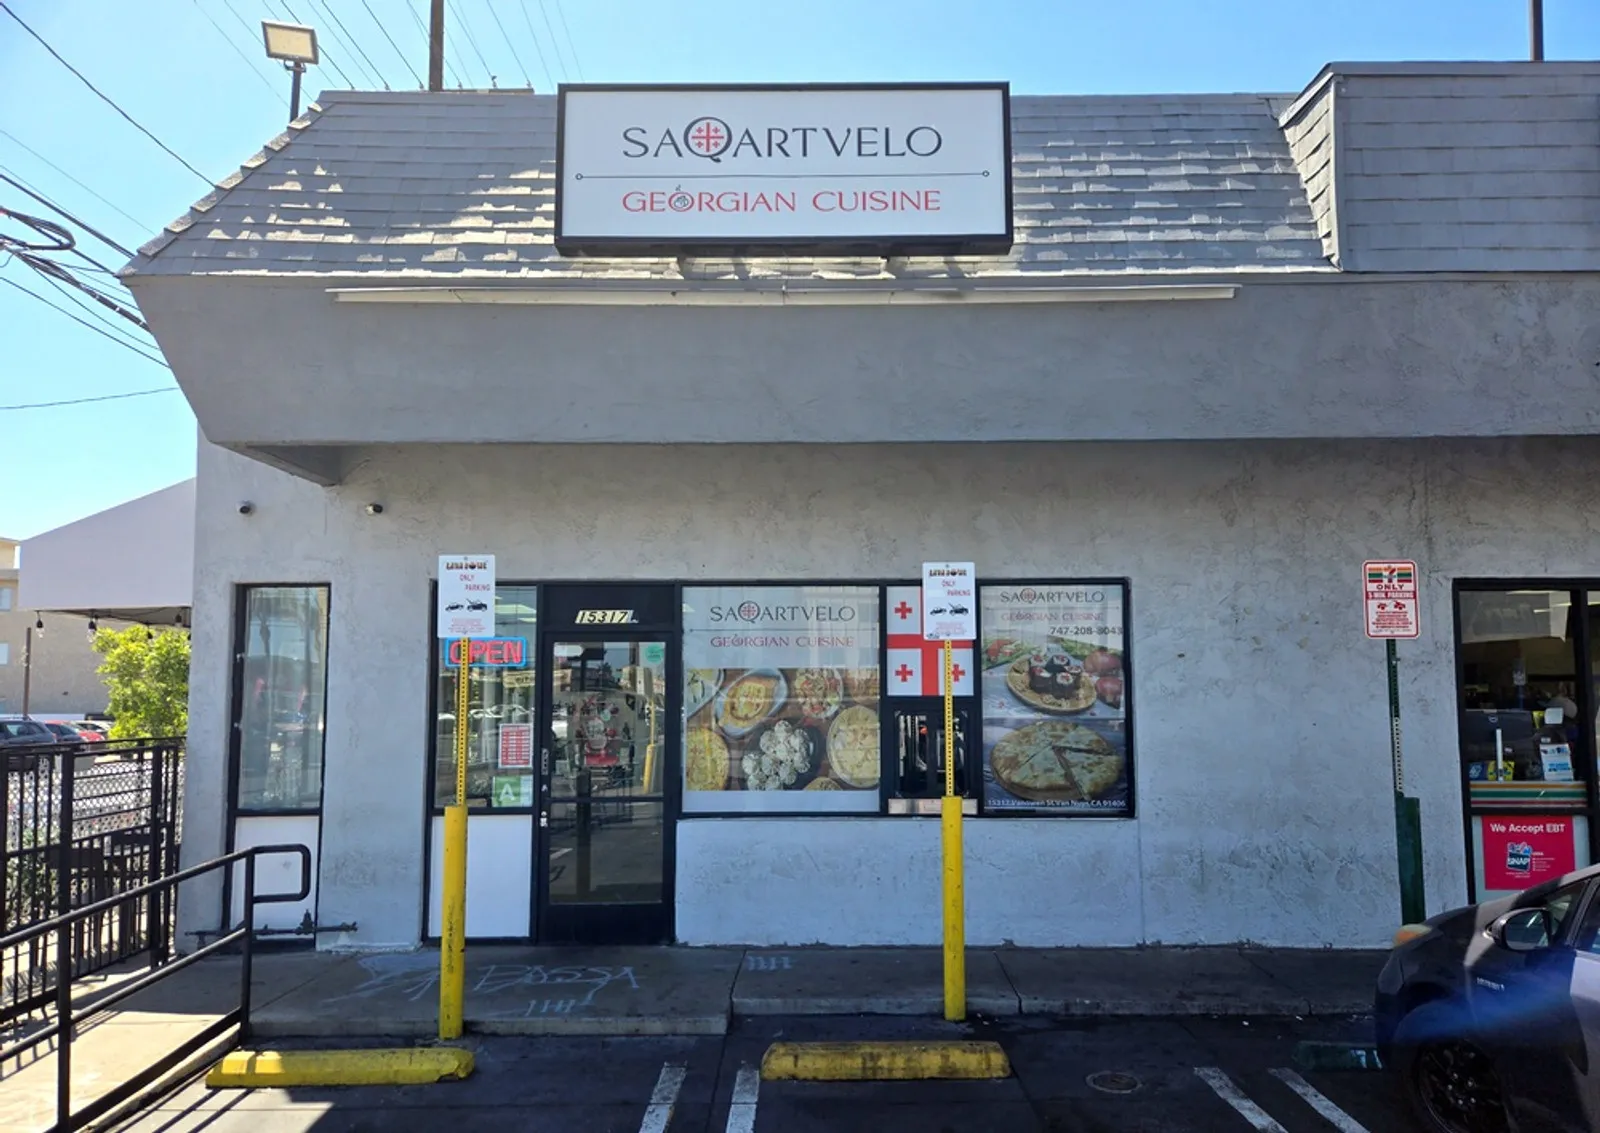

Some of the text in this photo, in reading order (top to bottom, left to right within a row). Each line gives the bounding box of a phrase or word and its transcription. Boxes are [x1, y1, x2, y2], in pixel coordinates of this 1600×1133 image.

[622, 116, 943, 163] SAQARTVELO
[622, 187, 941, 213] GEORGIAN CUISINE
[1000, 587, 1105, 604] SAQARTVELO
[579, 610, 629, 623] 15317
[710, 600, 856, 624] SAQARTVELO
[1001, 611, 1104, 621] GEORGIAN CUISINE
[710, 634, 854, 648] GEORGIAN CUISINE
[450, 639, 523, 664] OPEN
[499, 783, 516, 801] A
[1490, 823, 1565, 835] We Accept EBT
[1507, 857, 1530, 866] SNAP
